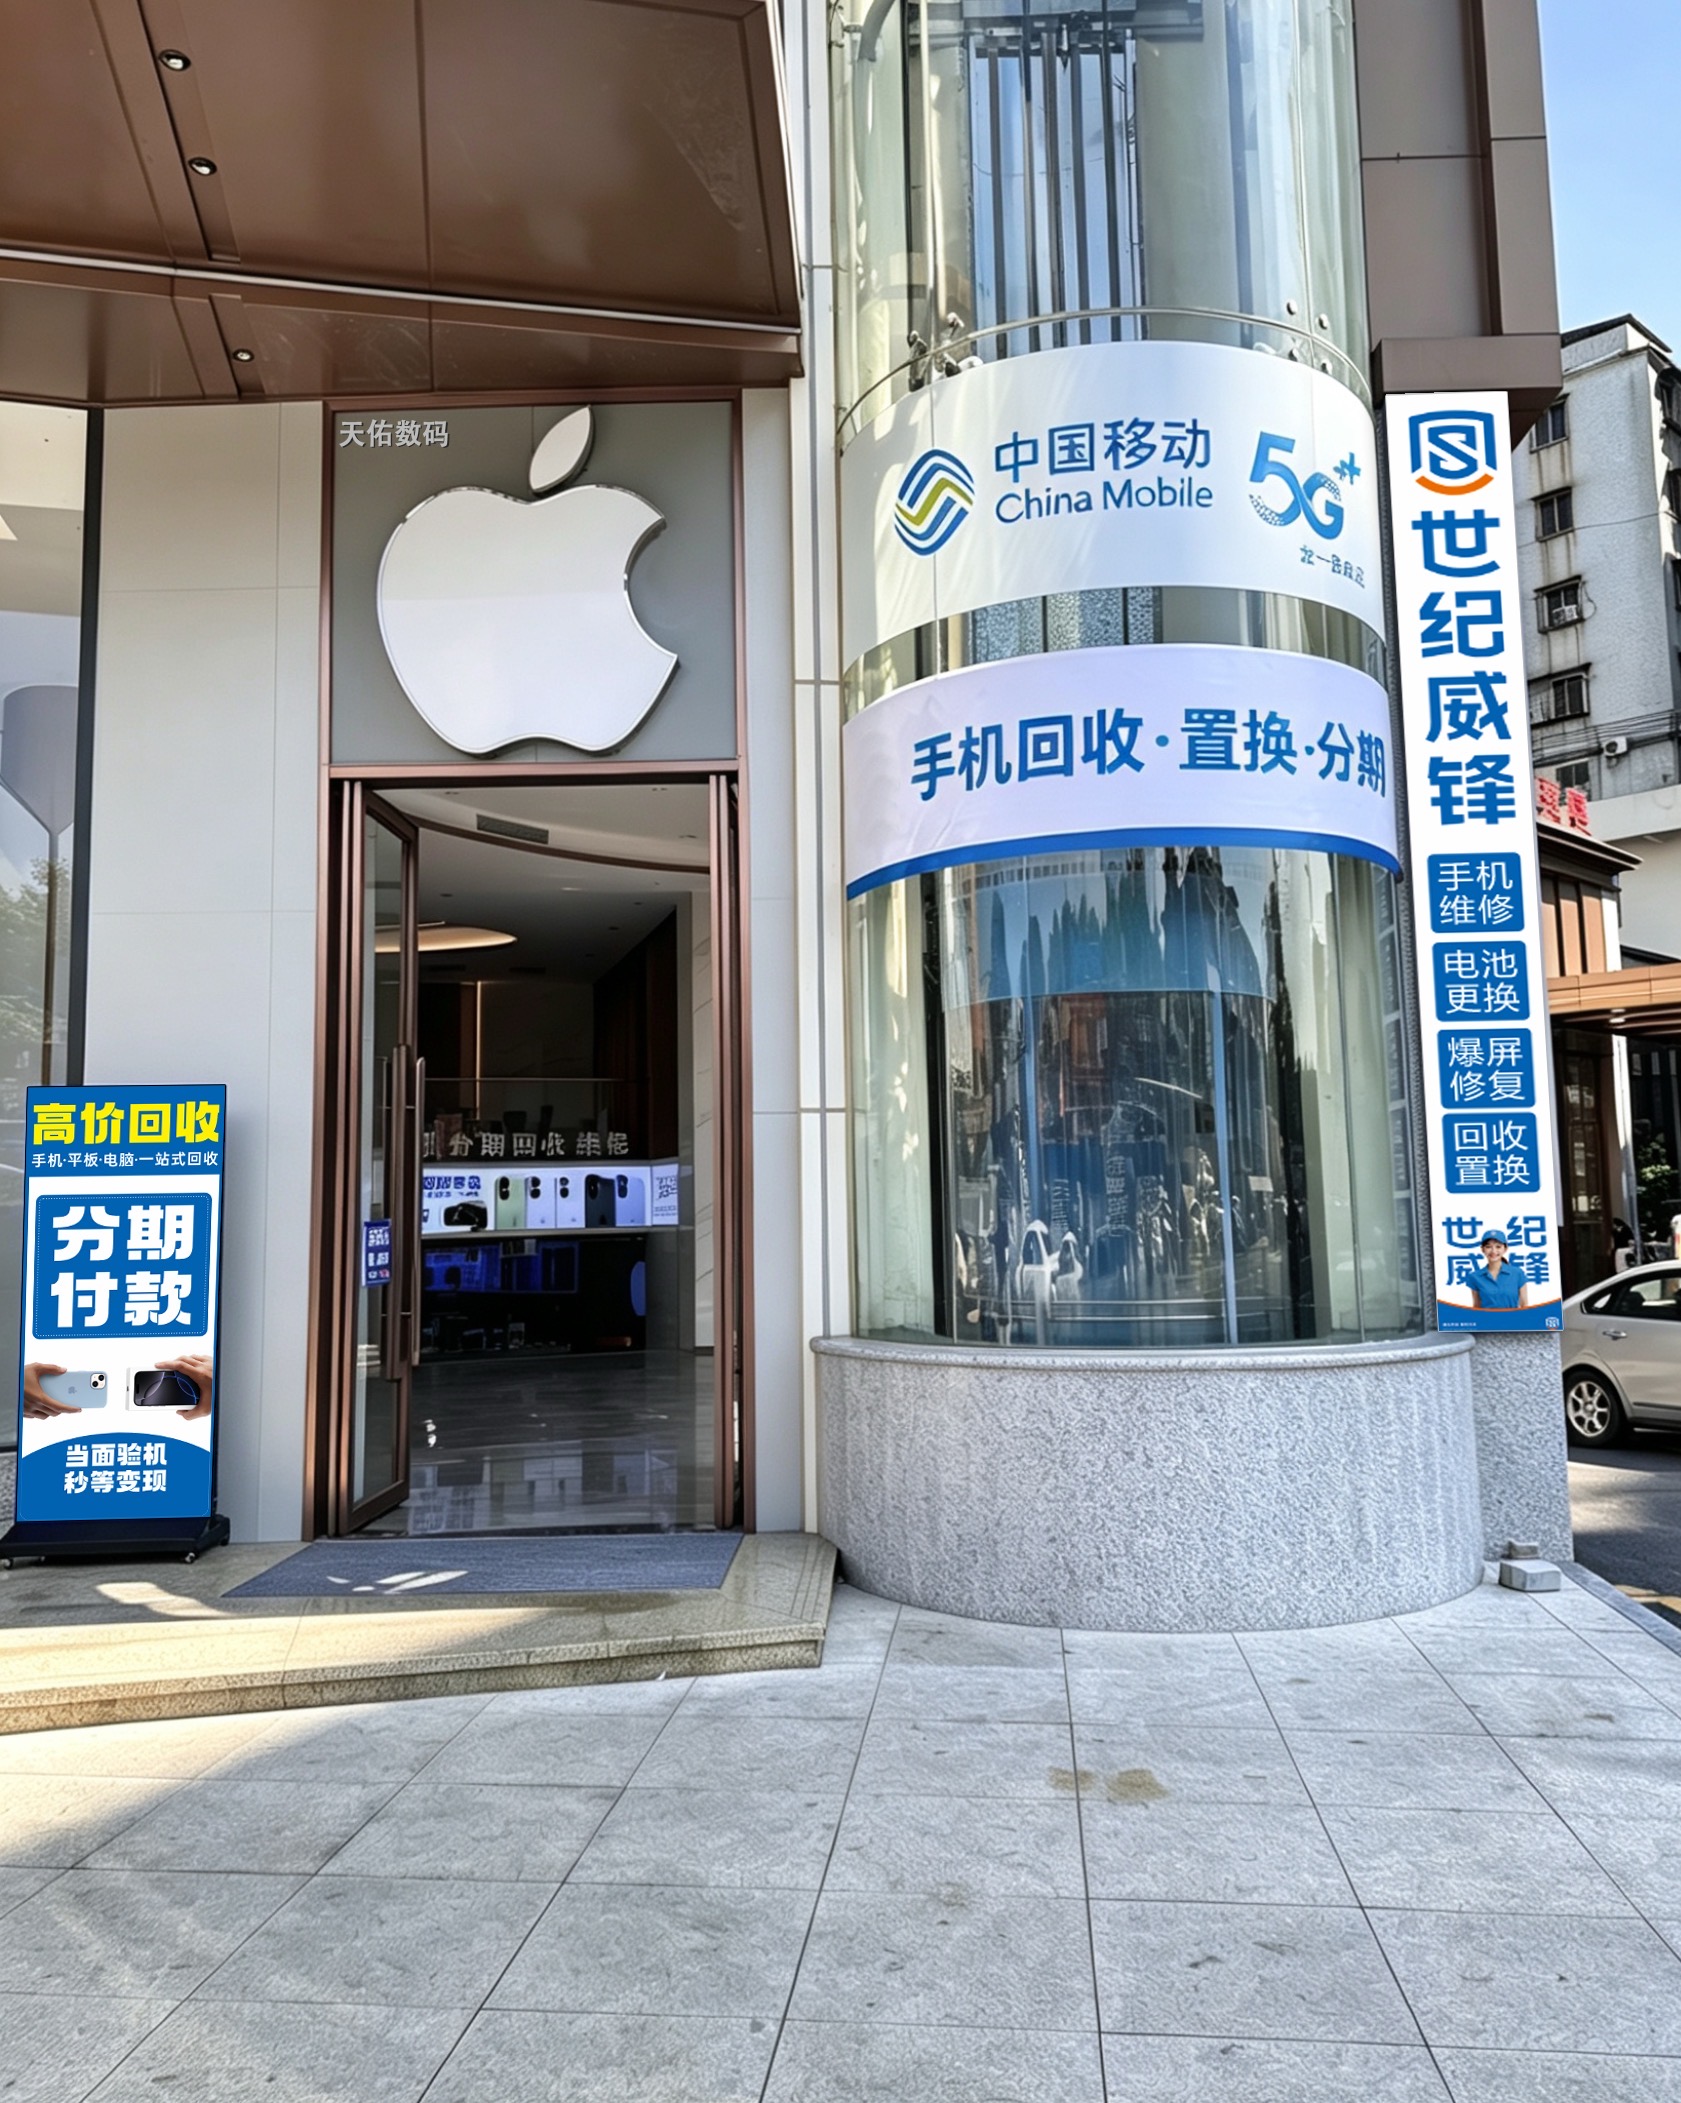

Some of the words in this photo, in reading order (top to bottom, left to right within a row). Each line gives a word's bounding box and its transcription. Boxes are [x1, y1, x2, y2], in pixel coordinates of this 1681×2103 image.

[340, 419, 449, 447] 天佑数码
[995, 418, 1210, 483] 中国移动
[996, 486, 1092, 523] China
[1103, 477, 1213, 511] Mobile
[1411, 509, 1516, 825] 世纪威锋
[1438, 861, 1513, 891] 手机
[1440, 894, 1514, 925] 维修
[1444, 948, 1518, 979] 电池
[1446, 982, 1520, 1014] 更换
[1448, 1037, 1523, 1068] 爆屏
[1450, 1070, 1525, 1102] 修复
[33, 1101, 220, 1145] 高价回收
[1454, 1120, 1528, 1152] 回收
[1455, 1154, 1530, 1186] 置换
[52, 1204, 195, 1262] 分期
[1442, 1216, 1546, 1248] 世纪
[50, 1270, 192, 1328] 付款
[65, 1442, 167, 1468] 当面验机
[64, 1469, 167, 1494] 秒等变现
